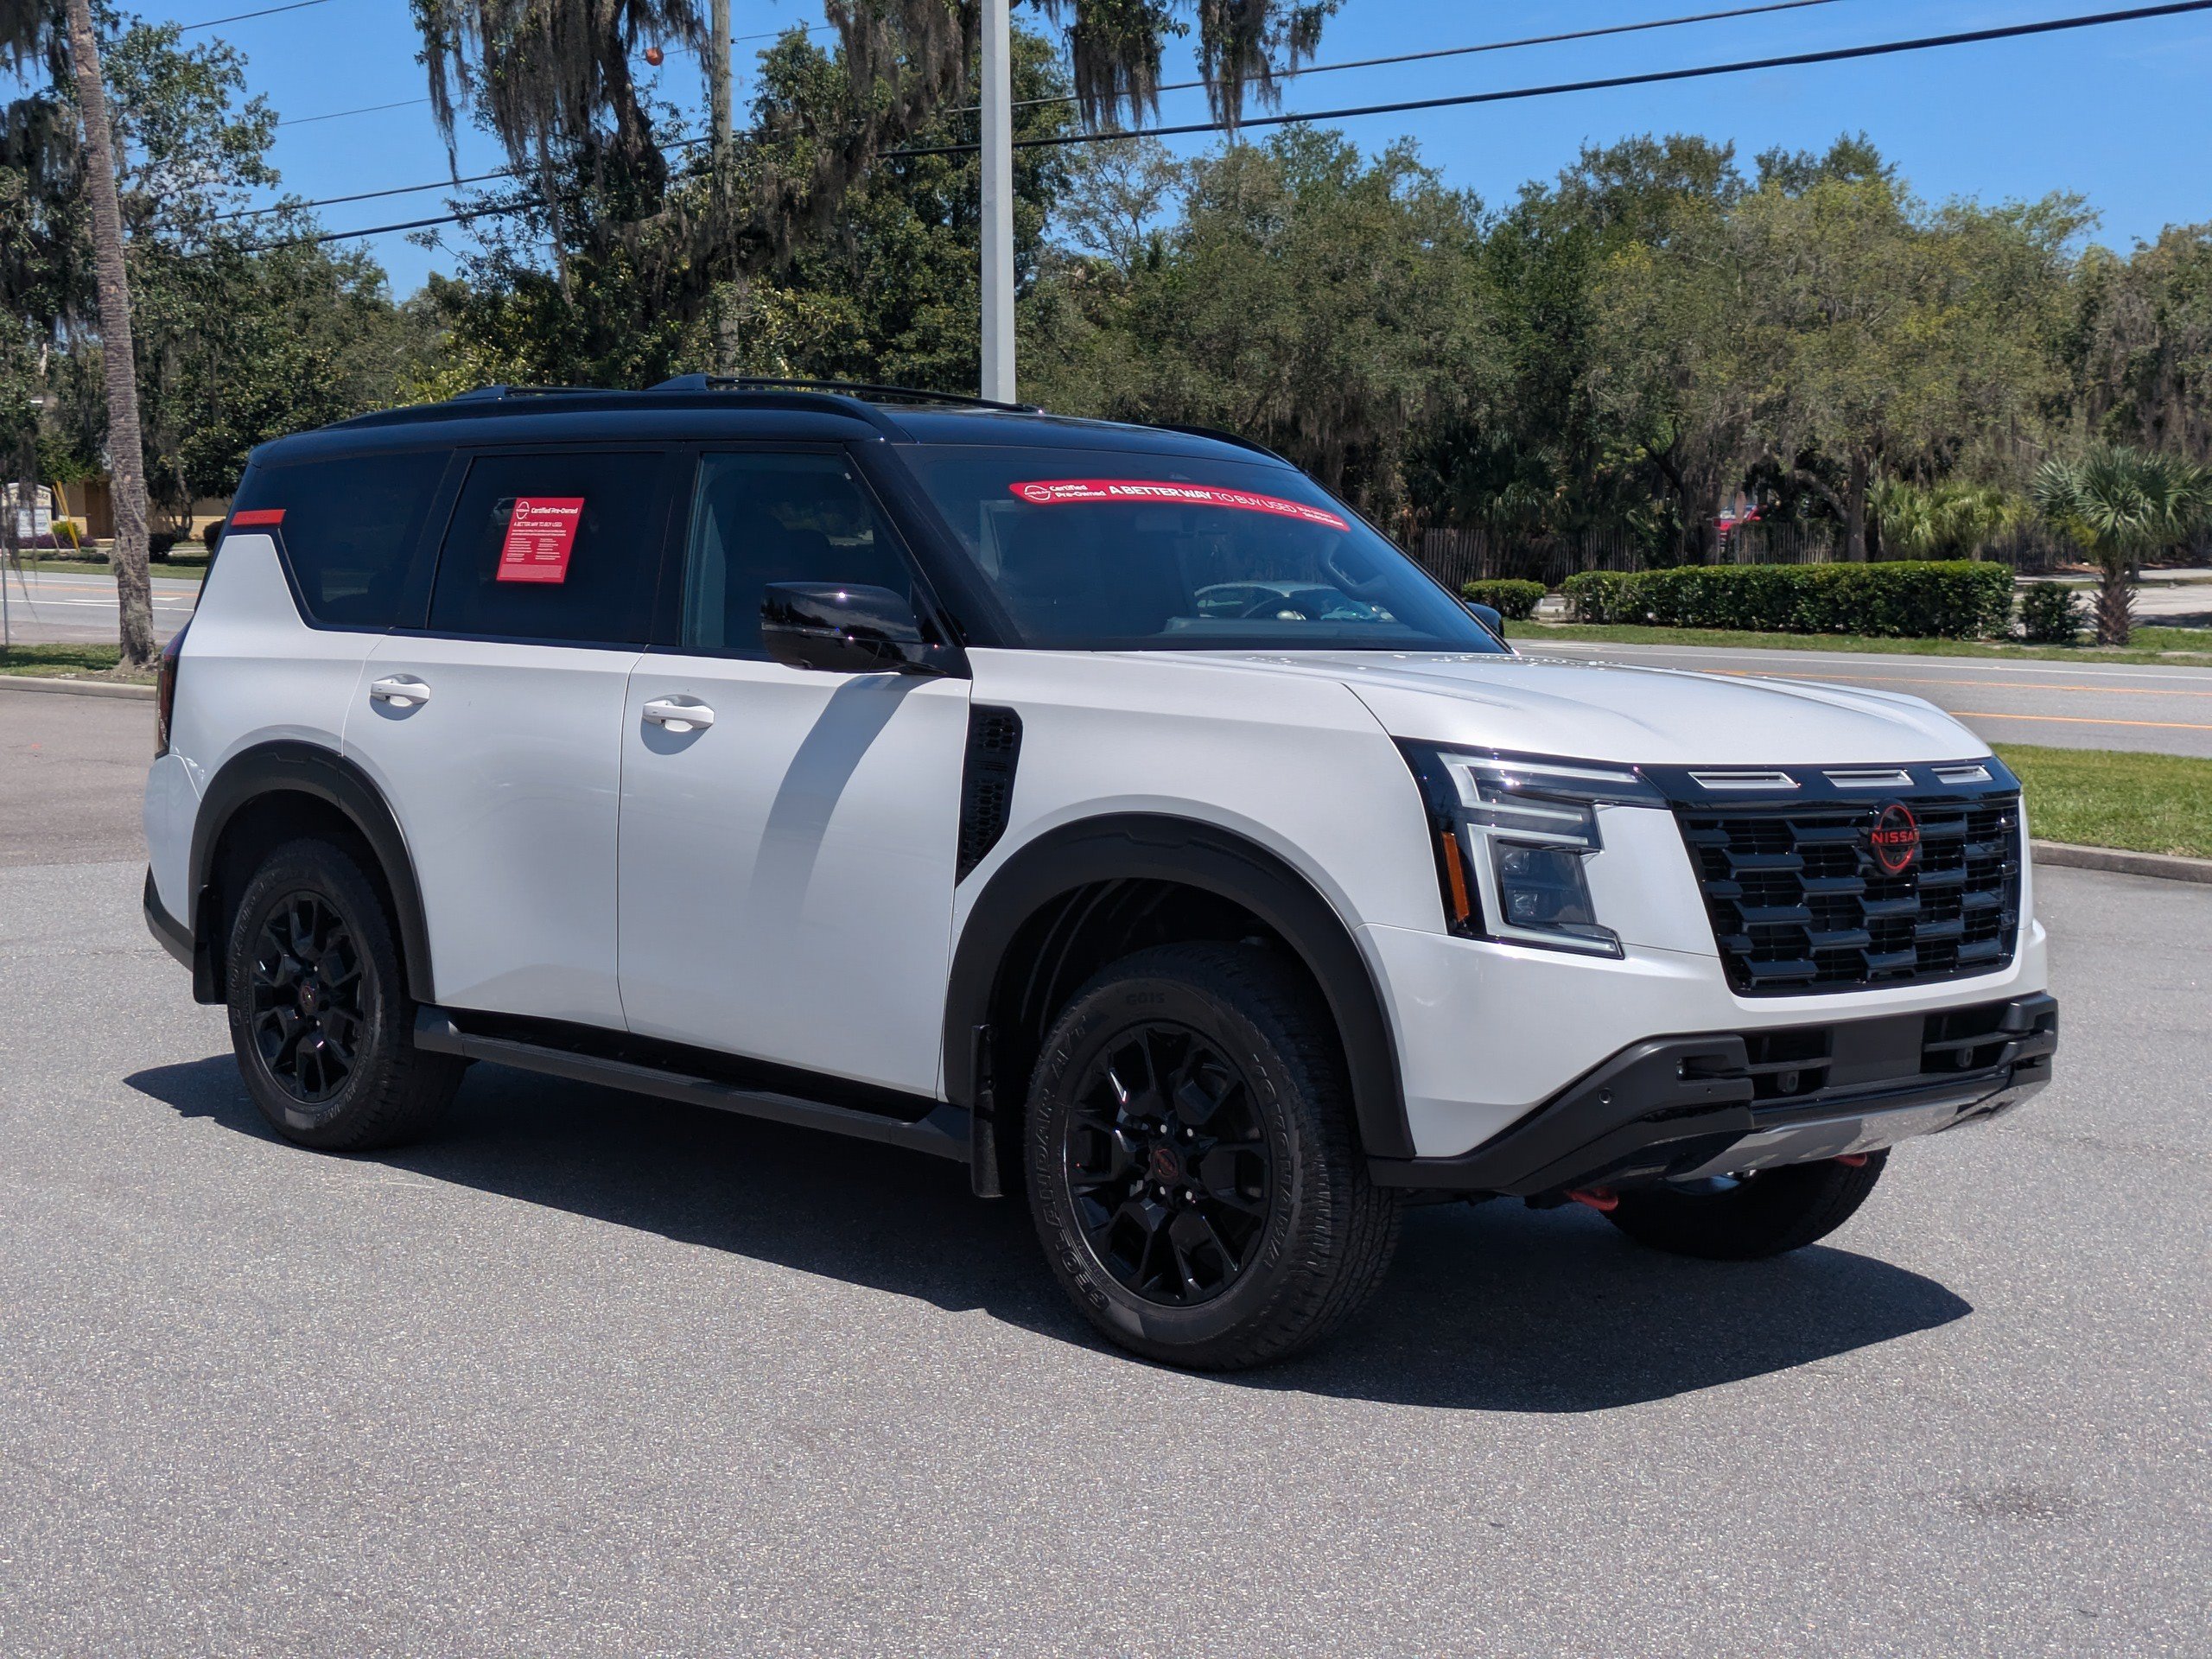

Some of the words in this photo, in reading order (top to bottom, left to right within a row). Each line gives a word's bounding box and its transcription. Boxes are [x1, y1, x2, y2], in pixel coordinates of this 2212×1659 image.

[1109, 486, 1124, 494] A
[1120, 486, 1183, 497] BETTER
[1177, 488, 1212, 499] WAY
[1211, 493, 1234, 502] TO
[1234, 495, 1262, 507] BUY
[1261, 499, 1298, 513] USED
